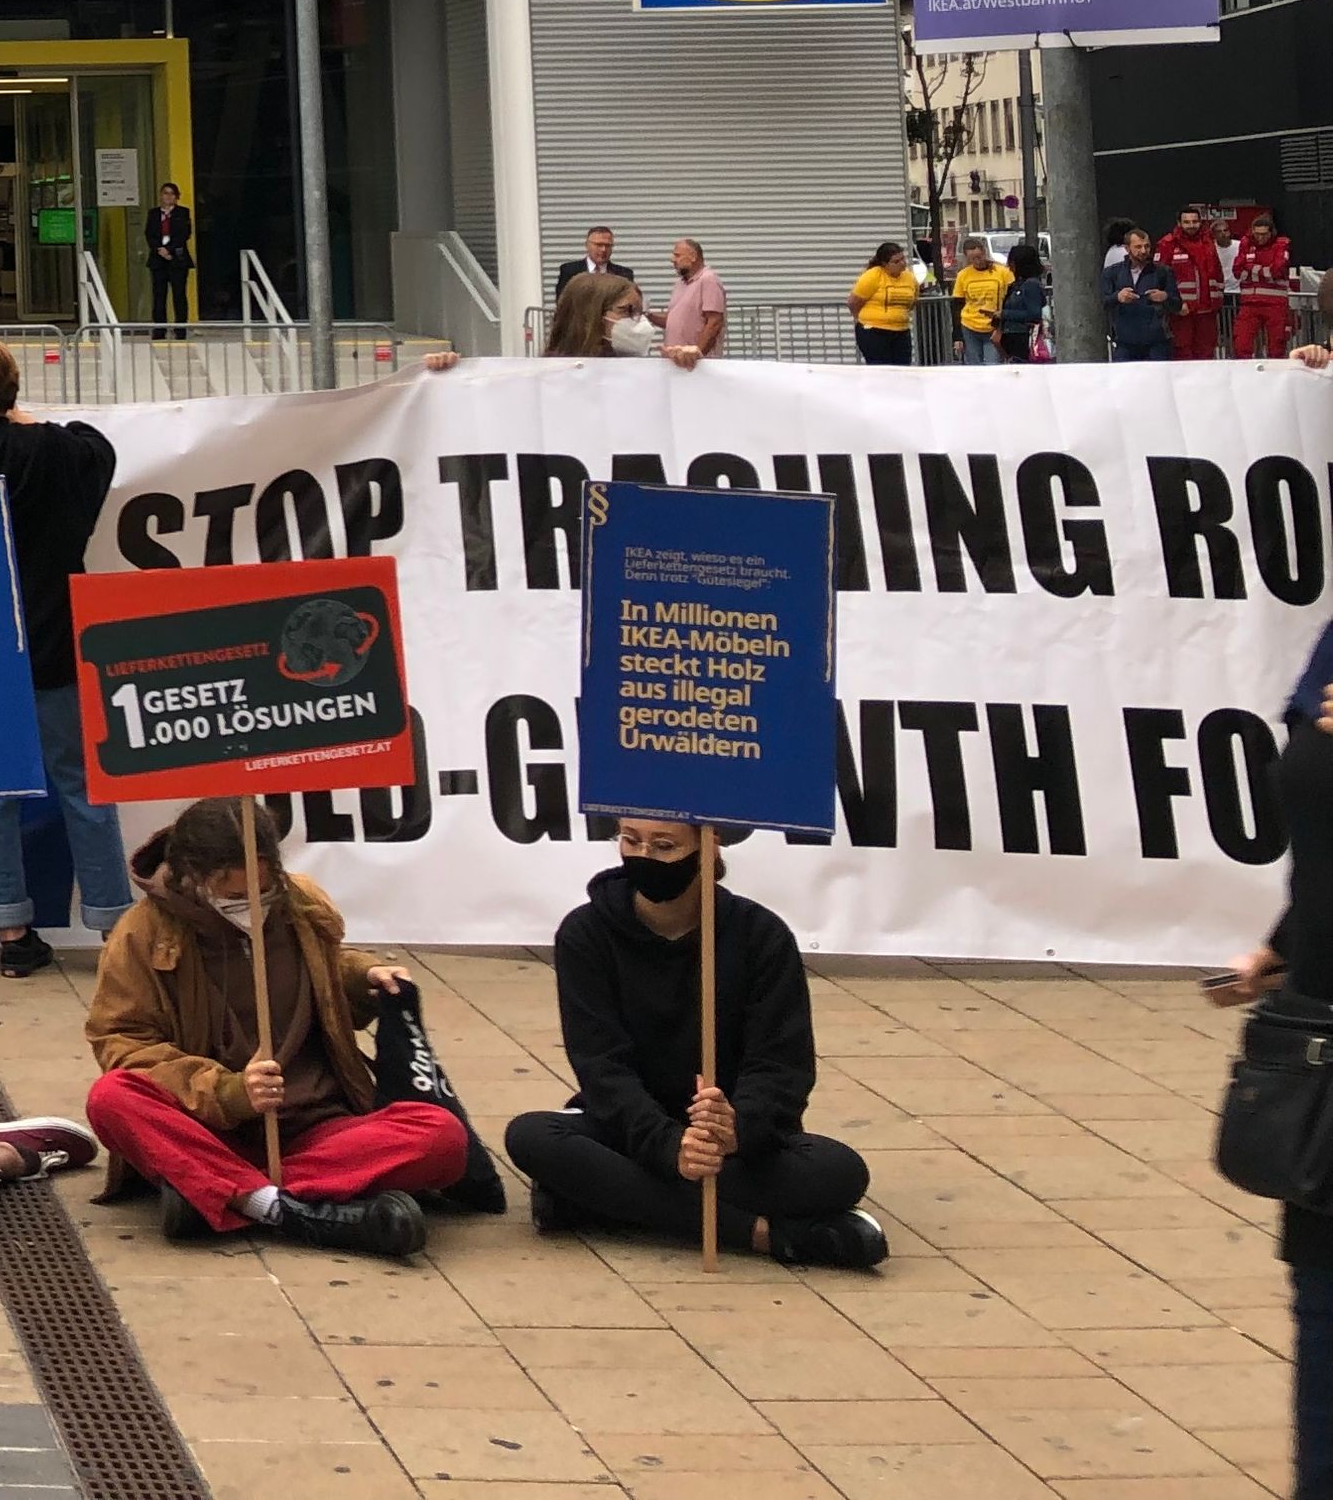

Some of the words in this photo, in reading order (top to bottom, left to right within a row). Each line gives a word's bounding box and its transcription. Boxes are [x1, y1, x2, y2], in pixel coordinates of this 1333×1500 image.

[117, 457, 405, 571] STOP
[439, 451, 1115, 599] TRHING
[1146, 455, 1333, 607] RO
[624, 546, 652, 558] IKEA
[690, 551, 726, 564] wieso
[729, 556, 743, 565] es
[745, 555, 765, 567] ein
[624, 558, 736, 578] Lieferkettengesetz
[624, 569, 656, 581] Denn
[659, 572, 688, 583] trotz
[620, 599, 647, 622] In
[654, 600, 777, 631] Millionen
[620, 623, 790, 658] IKEA-Möbeln
[105, 642, 269, 677] LIEFERKETTENGESETZ
[620, 649, 700, 677] steckt
[707, 656, 765, 682] Holz
[142, 678, 247, 714] GESETZ
[619, 678, 667, 700] aus
[672, 679, 751, 712] illegal
[217, 691, 376, 735] LÖSUNGEN
[619, 701, 757, 738] gerodeten
[245, 741, 391, 771] LIEFERKETTENGESETZ.AT
[619, 724, 760, 760] Urwäldern
[1122, 707, 1291, 866] FO
